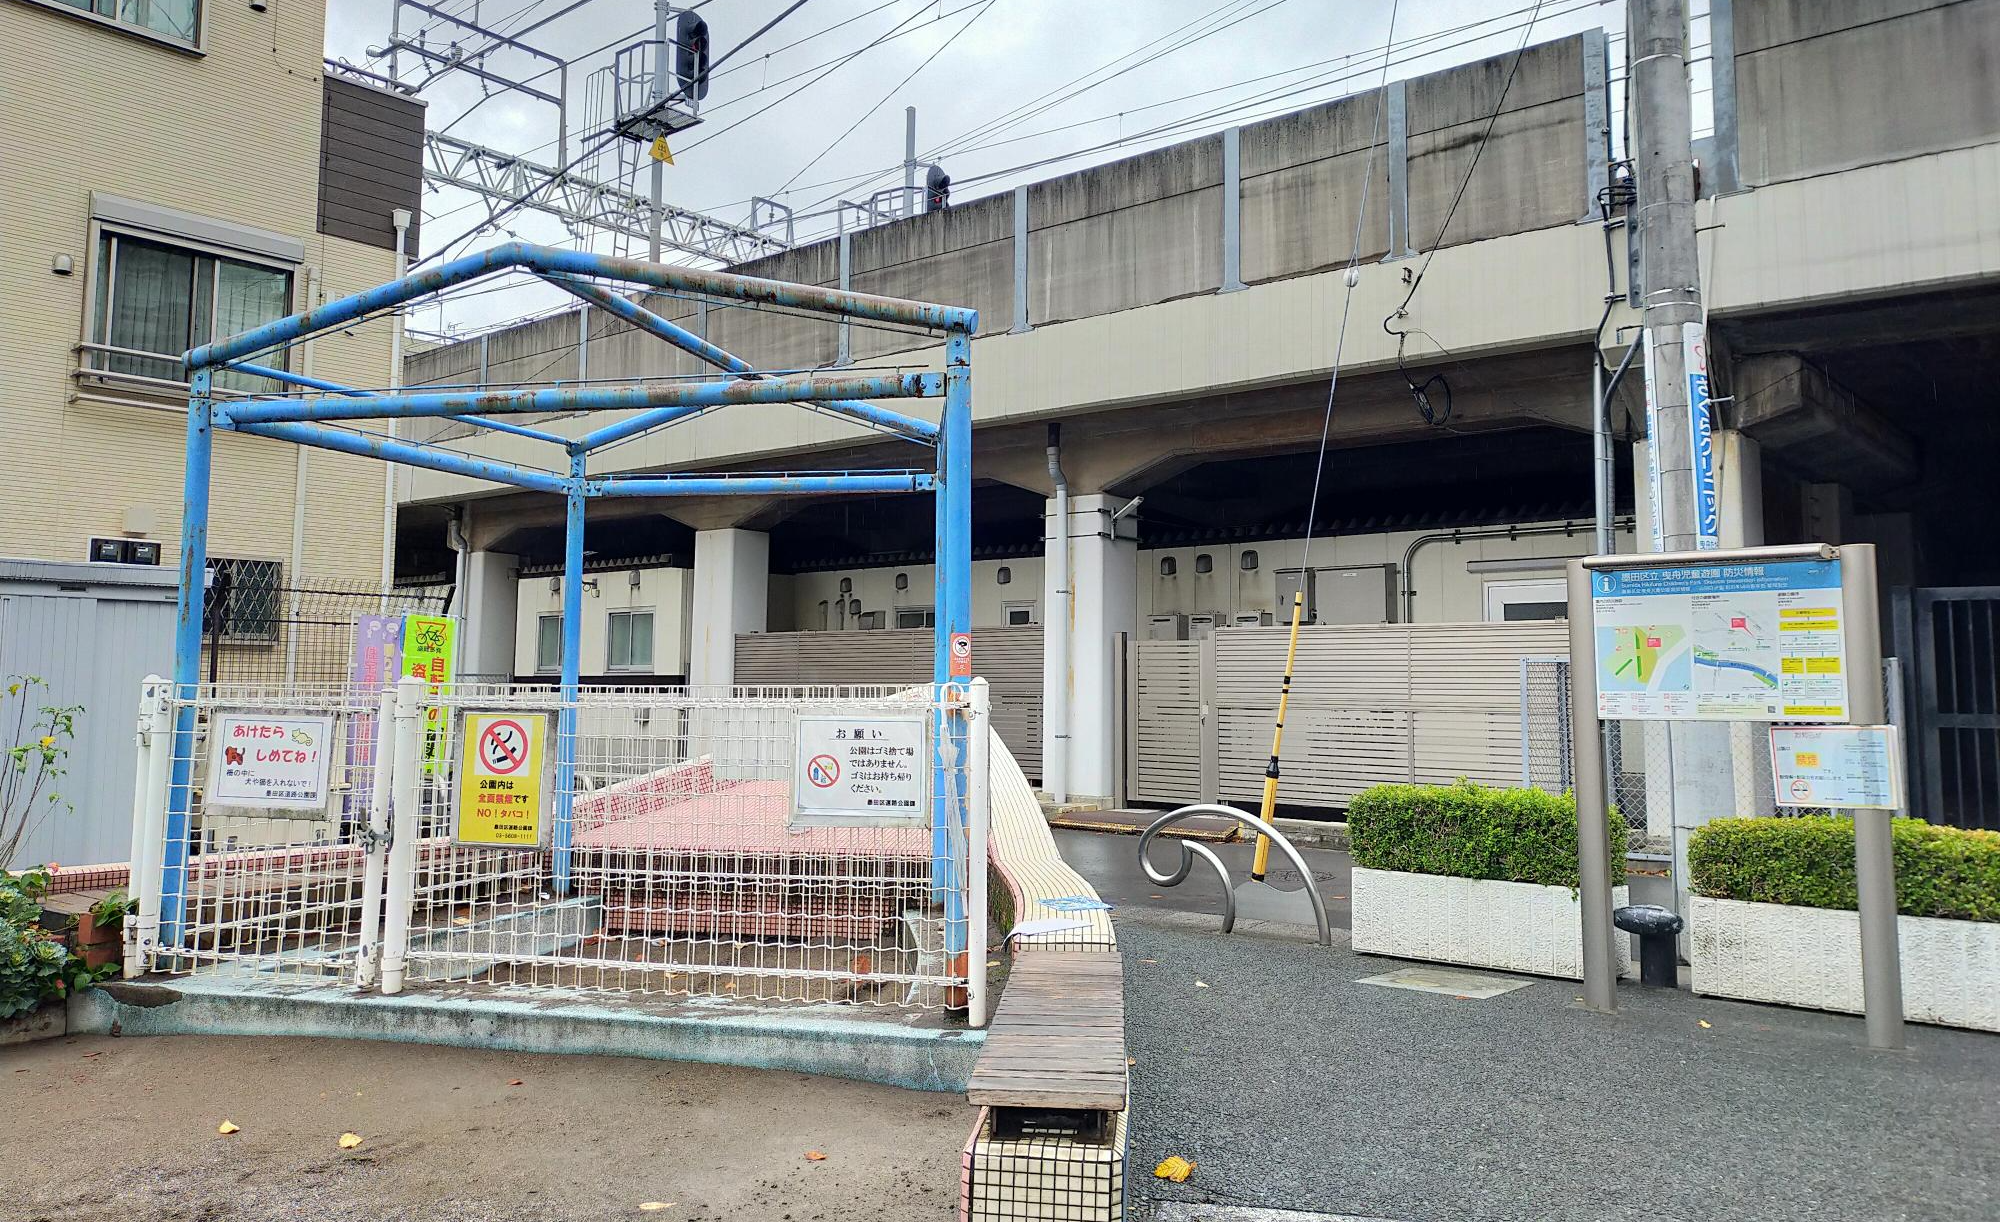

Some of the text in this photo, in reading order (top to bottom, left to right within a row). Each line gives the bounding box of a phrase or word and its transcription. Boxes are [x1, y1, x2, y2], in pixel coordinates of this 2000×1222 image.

[1723, 566, 1765, 577] 防災情報
[233, 724, 285, 739] あけたら
[835, 728, 883, 740] お願い
[256, 748, 318, 764] しめてね！
[849, 746, 914, 757] 公園はゴミ捨て場
[849, 759, 908, 770] ではありません。
[226, 769, 255, 777] 柵の中に
[850, 771, 912, 782] ゴミはお持ち帰り
[480, 780, 514, 789] 公園内は
[850, 783, 883, 794] ください。
[479, 794, 528, 803] 全面禁煙です
